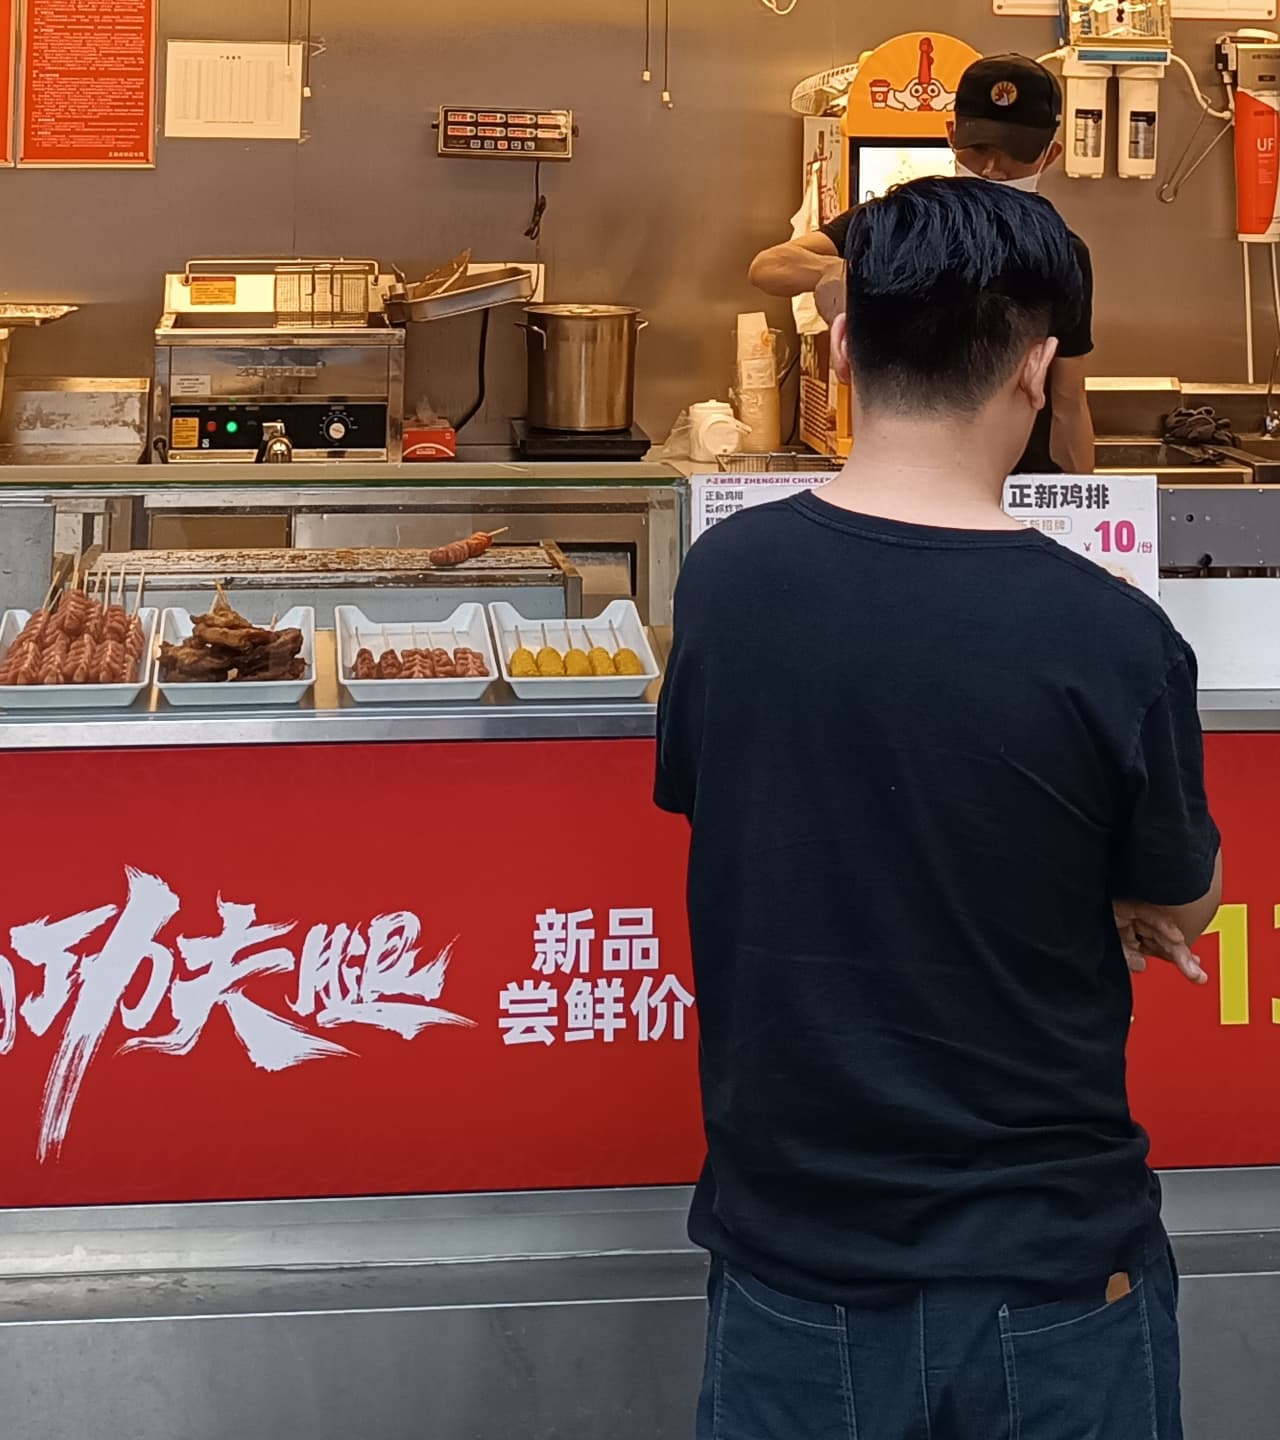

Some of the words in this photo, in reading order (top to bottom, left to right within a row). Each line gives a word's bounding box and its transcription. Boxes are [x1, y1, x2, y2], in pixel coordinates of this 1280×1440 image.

[1257, 137, 1274, 151] UF
[1008, 483, 1110, 510] 正新鸡排
[530, 906, 660, 975] 新品
[495, 976, 697, 1047] 尝鲜价
